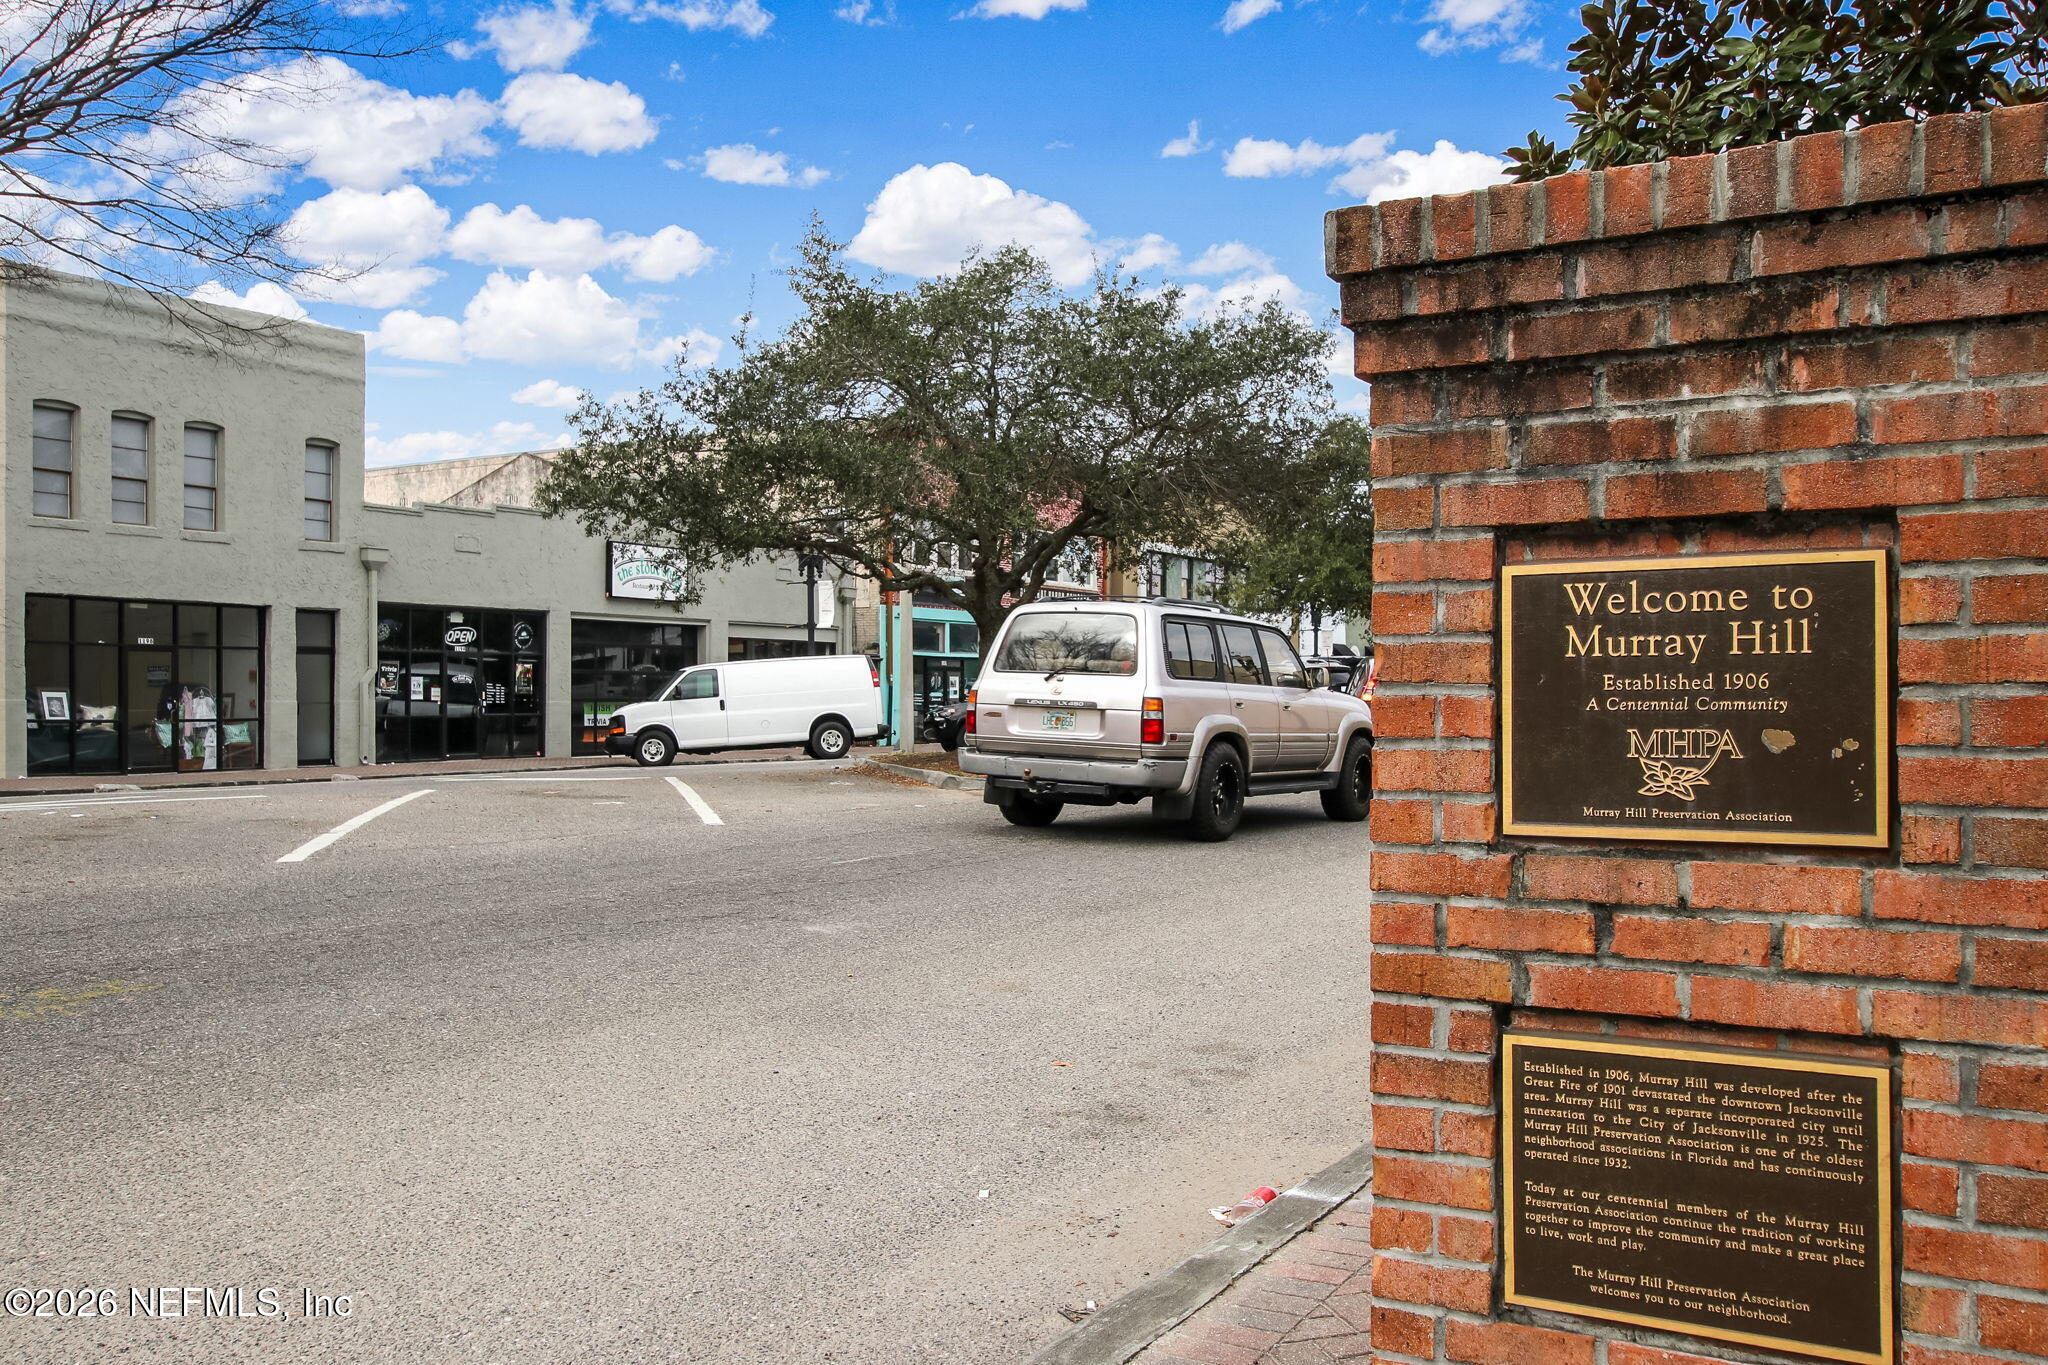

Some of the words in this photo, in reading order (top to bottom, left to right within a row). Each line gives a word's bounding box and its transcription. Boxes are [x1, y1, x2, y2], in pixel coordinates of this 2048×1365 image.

[617, 565, 633, 581] the
[1563, 579, 1749, 616] Welcome
[1771, 585, 1814, 611] to
[446, 630, 473, 643] OPEN
[1565, 624, 1708, 665] Murray
[1728, 618, 1813, 655] Hill
[1602, 671, 1714, 691] Established
[1723, 671, 1771, 690] 1906
[590, 704, 611, 712] IISH
[1585, 697, 1600, 712] A
[1607, 696, 1690, 712] Centennial
[1696, 696, 1788, 714] Community
[1627, 727, 1744, 759] MHPA
[1583, 806, 1622, 820] Murray
[1625, 807, 1648, 819] Hill
[1652, 808, 1721, 821] Preservation
[1725, 810, 1793, 823] Association
[1524, 1061, 1584, 1077] Established
[1589, 1068, 1601, 1079] in
[1605, 1069, 1634, 1084] 1906,
[1639, 1072, 1680, 1089] Murray
[1685, 1076, 1708, 1090] Hill
[1714, 1082, 1735, 1093] was
[1740, 1082, 1801, 1100] developed
[1807, 1089, 1837, 1103] after
[1843, 1093, 1863, 1105] the
[1524, 1075, 1555, 1089] Great
[1560, 1079, 1582, 1092] Fire
[1586, 1082, 1599, 1093] of
[1603, 1083, 1627, 1096] 1901
[1632, 1086, 1692, 1103] devastated
[1697, 1093, 1716, 1106] the
[1721, 1095, 1783, 1113] downtown
[1787, 1102, 1863, 1121] Jacksonville
[1524, 1092, 1550, 1102] area.
[1555, 1093, 1595, 1109] Murray
[1599, 1097, 1622, 1111] Hill
[1628, 1103, 1648, 1113] was
[1653, 1106, 1660, 1115] a
[1665, 1107, 1713, 1120] separate
[1719, 1111, 1796, 1129] incorporated
[1802, 1121, 1826, 1134] city
[1833, 1125, 1864, 1137] until
[1524, 1107, 1586, 1121] annexation
[1593, 1114, 1606, 1123] to
[1613, 1114, 1632, 1126] the
[1639, 1117, 1666, 1132] City
[1673, 1121, 1686, 1132] of
[1692, 1122, 1767, 1141] Jacksonville
[1776, 1133, 1789, 1144] in
[1798, 1134, 1829, 1148] 1925.
[1838, 1138, 1864, 1152] The
[1524, 1118, 1563, 1135] Murray
[1567, 1123, 1588, 1136] Hill
[1593, 1126, 1662, 1145] Preservation
[1667, 1135, 1735, 1153] Association
[1741, 1144, 1750, 1155] is
[1755, 1148, 1778, 1158] one
[1783, 1149, 1797, 1160] of
[1801, 1150, 1821, 1163] the
[1826, 1153, 1864, 1168] oldest
[1524, 1135, 1596, 1151] neighborhood
[1600, 1144, 1666, 1160] associations
[1671, 1151, 1683, 1162] in
[1688, 1151, 1729, 1167] Florida
[1733, 1159, 1755, 1171] and
[1760, 1160, 1780, 1174] has
[1785, 1167, 1865, 1185] continuously
[1524, 1150, 1569, 1163] operated
[1573, 1154, 1601, 1167] since
[1604, 1157, 1632, 1170] 1932.
[1524, 1180, 1557, 1197] Today
[1563, 1189, 1575, 1198] at
[1581, 1191, 1601, 1201] our
[1607, 1194, 1669, 1210] centennial
[1677, 1204, 1728, 1218] members
[1736, 1210, 1750, 1221] of
[1757, 1212, 1777, 1225] the
[1785, 1215, 1830, 1234] Murray
[1839, 1222, 1865, 1237] Hill
[1525, 1195, 1591, 1214] Preservation
[1594, 1205, 1659, 1224] Association
[1663, 1217, 1713, 1231] continue
[1718, 1222, 1737, 1235] the
[1742, 1227, 1794, 1243] tradition
[1799, 1234, 1813, 1245] of
[1816, 1238, 1866, 1254] working
[1525, 1212, 1569, 1226] together
[1573, 1219, 1584, 1228] to
[1588, 1219, 1632, 1235] improve
[1636, 1225, 1654, 1238] the
[1658, 1231, 1722, 1249] community
[1725, 1240, 1747, 1251] and
[1751, 1244, 1782, 1256] make
[1786, 1249, 1793, 1258] a
[1798, 1251, 1829, 1263] great
[1833, 1254, 1866, 1268] place
[1526, 1227, 1537, 1236] to
[1540, 1226, 1564, 1241] live,
[1568, 1232, 1594, 1244] work
[1597, 1236, 1618, 1247] and
[1621, 1238, 1647, 1253] play.
[1572, 1265, 1594, 1279] The
[1597, 1269, 1637, 1287] Murray
[1640, 1275, 1663, 1289] Hill
[1667, 1279, 1737, 1301] Preservation
[1741, 1292, 1811, 1313] Association
[1590, 1284, 1641, 1300] welcomes
[1645, 1294, 1664, 1305] you
[1669, 1297, 1681, 1307] to
[1684, 1301, 1704, 1311] our
[1708, 1303, 1792, 1325] neighborhood.
